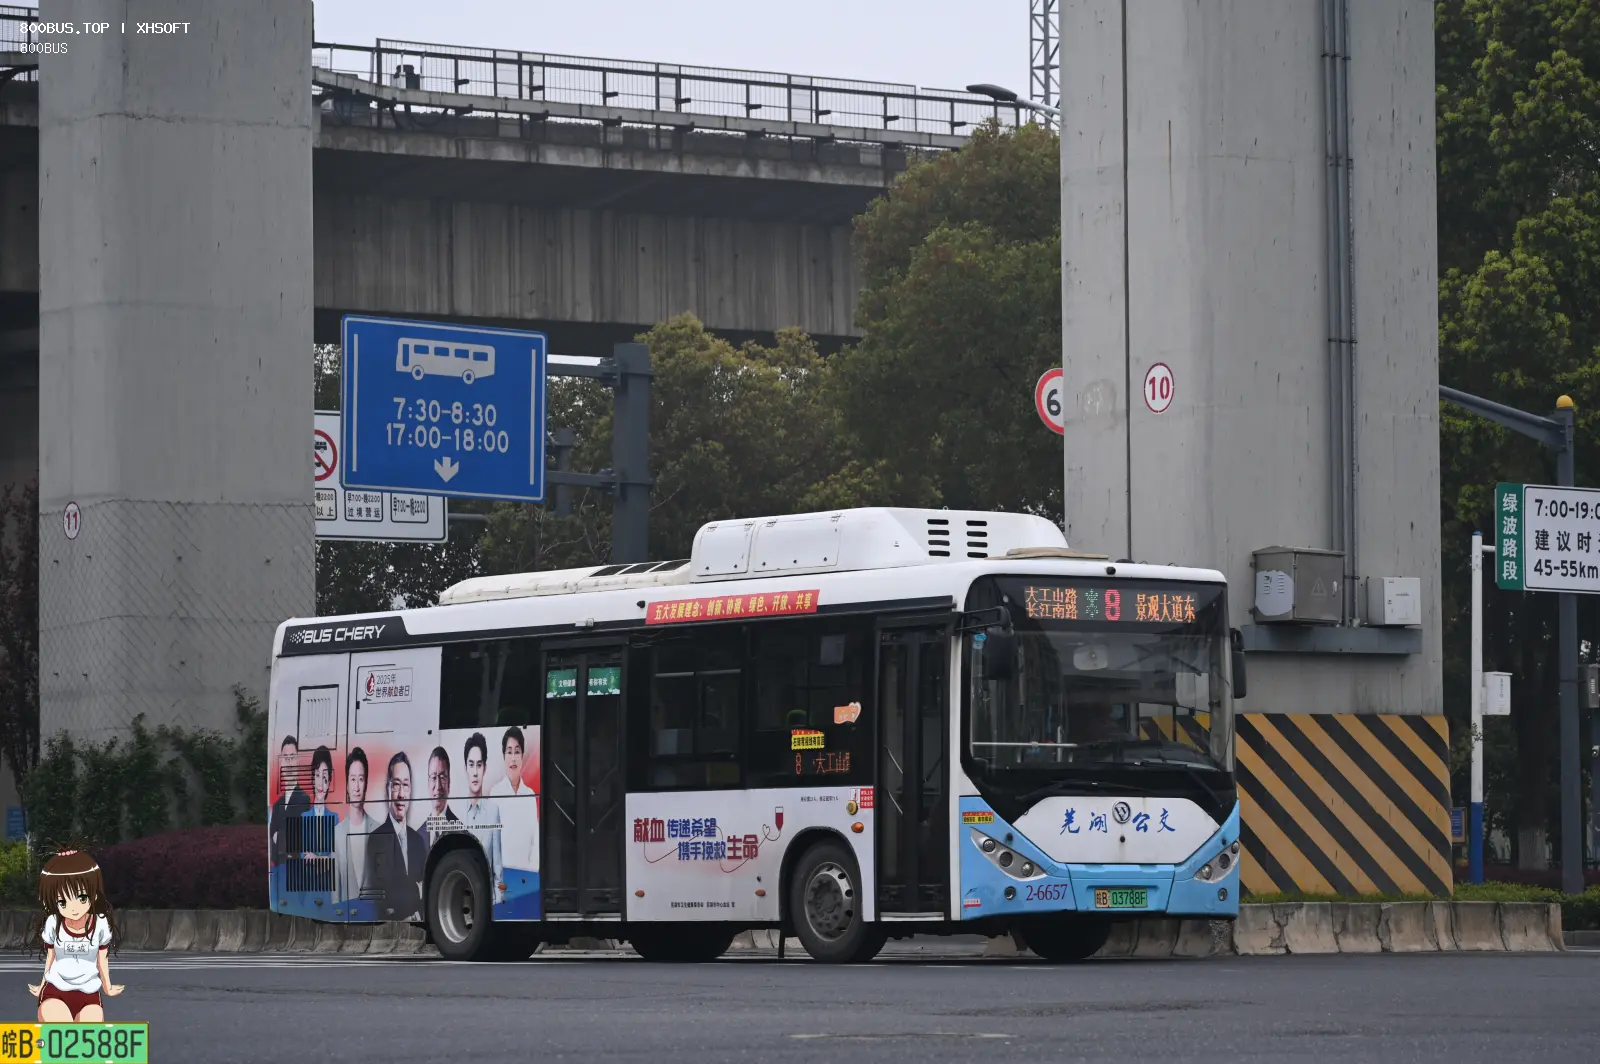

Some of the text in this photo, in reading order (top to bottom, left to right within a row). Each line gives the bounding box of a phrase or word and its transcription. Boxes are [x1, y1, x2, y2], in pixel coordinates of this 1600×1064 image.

[1148, 375, 1170, 401] 10
[393, 397, 497, 427] 7:30-8:30
[386, 422, 510, 453] 17:00-18:00
[65, 511, 78, 531] 11
[347, 506, 381, 519] 过境营运
[1502, 492, 1518, 581] 绿波路段
[1534, 528, 1600, 554] 建议时
[1025, 586, 1197, 623] 大工山路 8 景观大道东
[1025, 602, 1078, 620] 长江南路
[303, 624, 387, 644] BUS CHERY
[376, 674, 396, 685] 2025年
[375, 685, 410, 698] 世界献血者日
[795, 752, 802, 775] 8
[1060, 807, 1176, 836] 芜湖公交
[1025, 884, 1068, 901] 2-6657
[1111, 891, 1146, 905] 03788F
